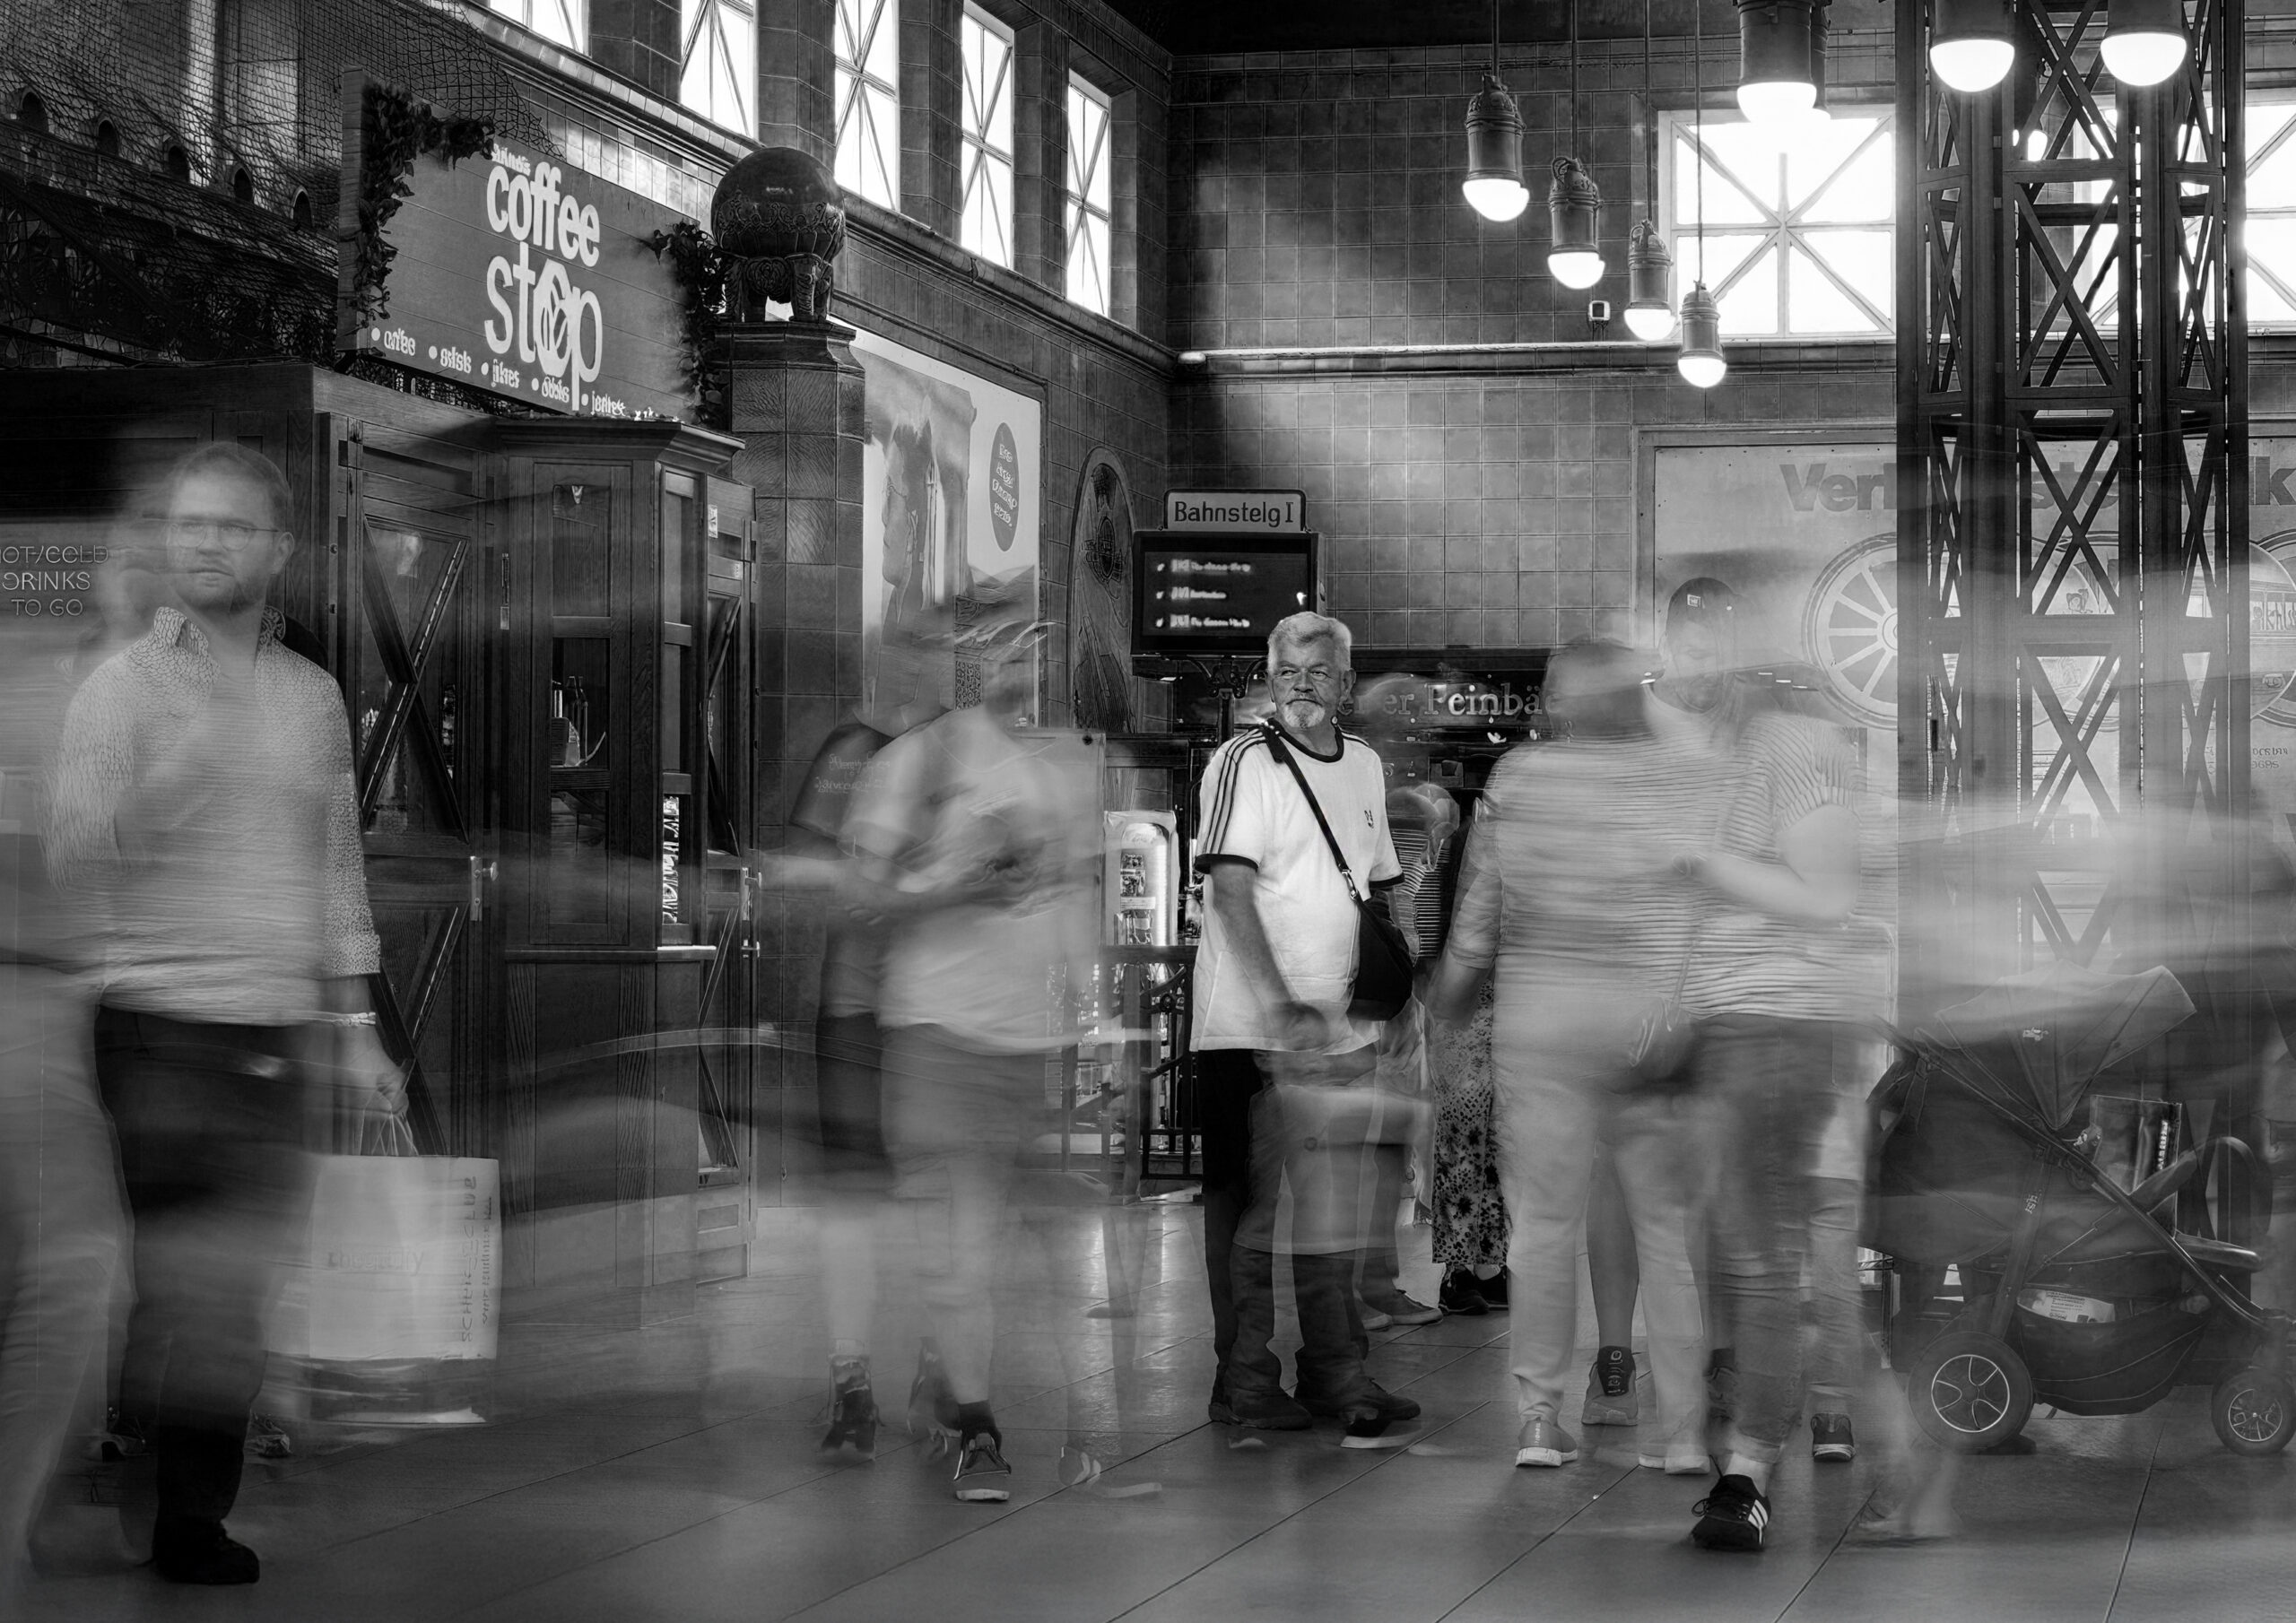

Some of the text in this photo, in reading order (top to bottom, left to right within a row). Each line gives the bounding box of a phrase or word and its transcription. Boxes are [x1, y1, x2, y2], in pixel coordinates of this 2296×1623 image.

[486, 161, 600, 267] coffee
[0, 544, 109, 565] OT/COLD
[11, 598, 83, 617] TO GO
